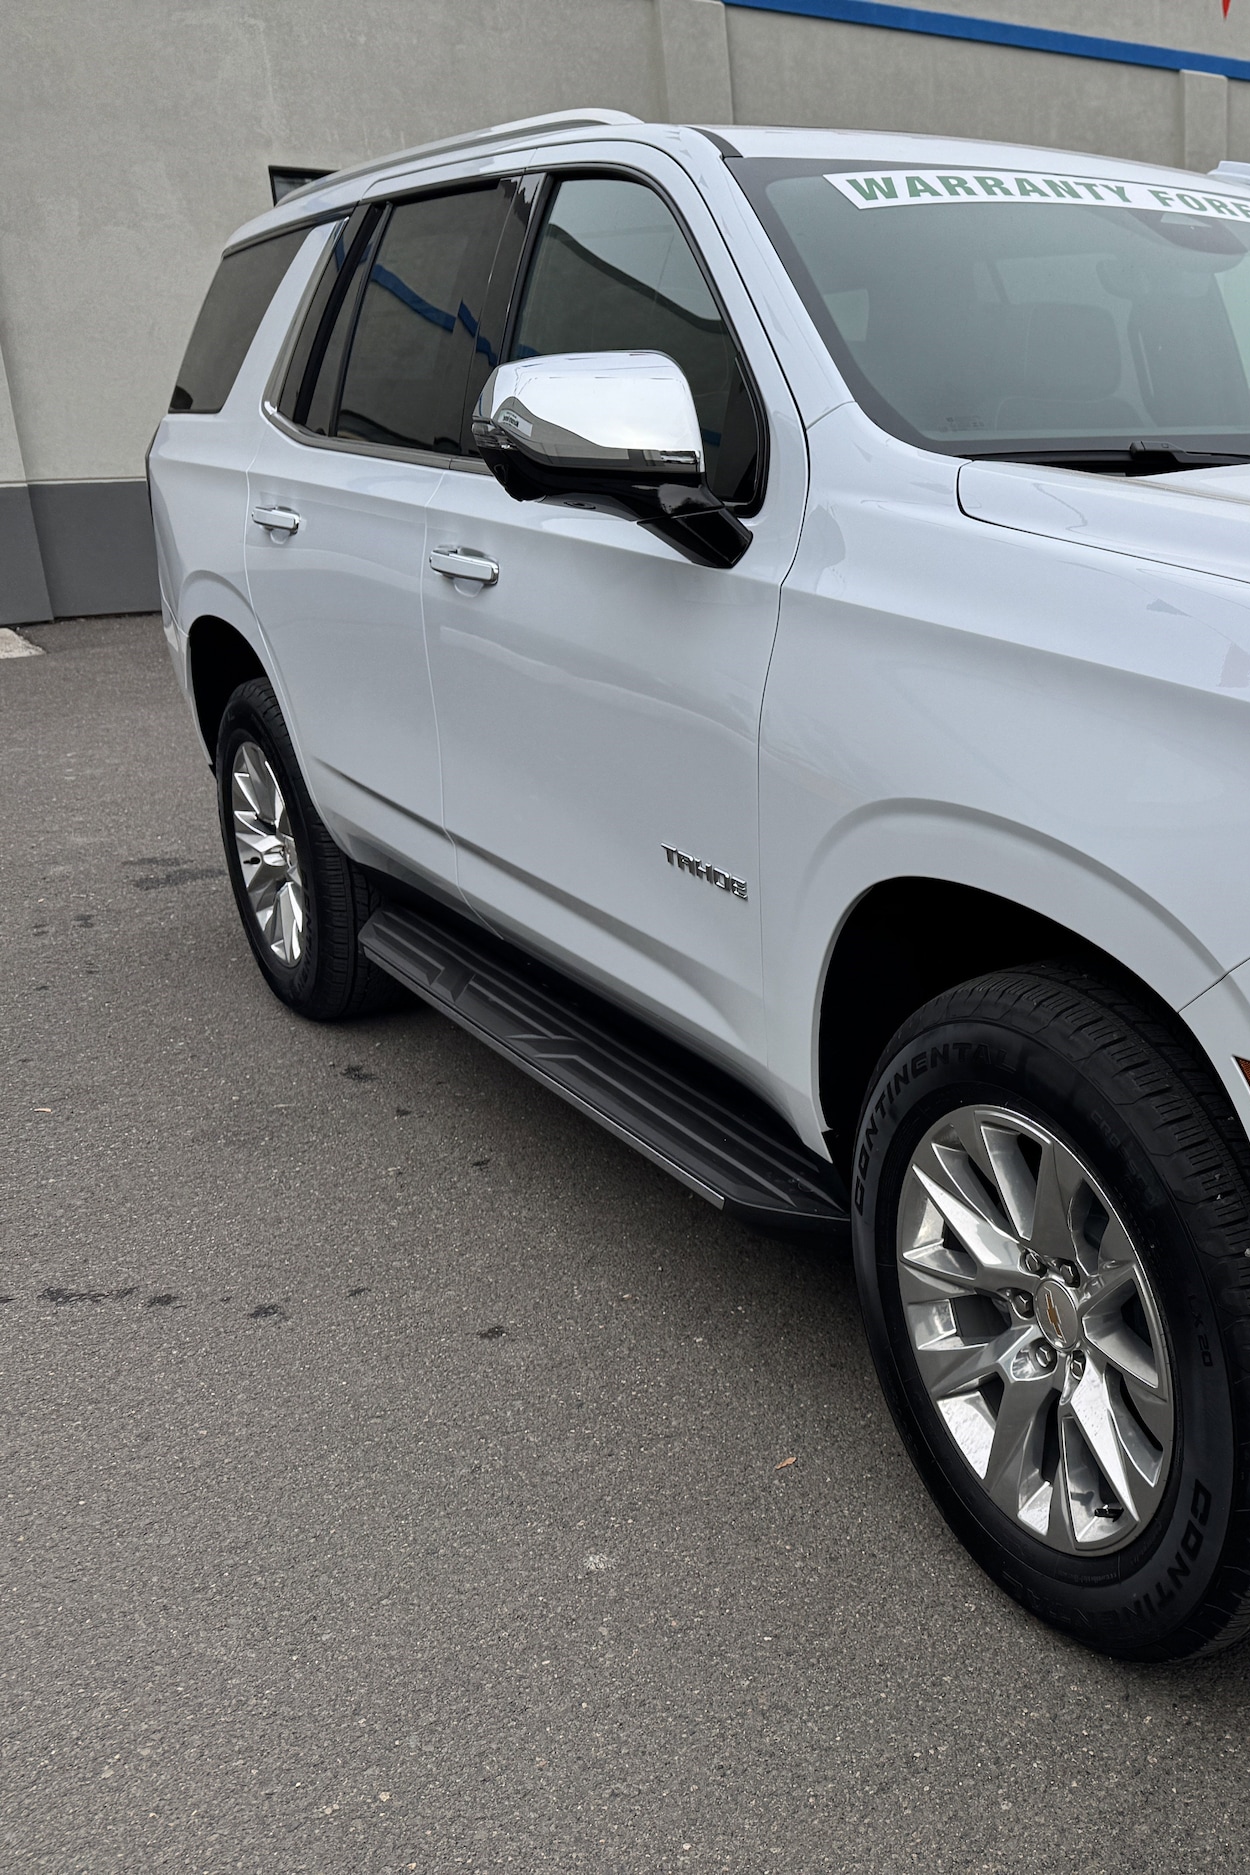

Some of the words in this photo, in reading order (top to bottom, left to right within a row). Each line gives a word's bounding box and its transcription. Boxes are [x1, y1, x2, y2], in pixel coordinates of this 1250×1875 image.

[845, 175, 1133, 203] WARRANTY
[660, 841, 749, 902] TAHOE
[854, 1040, 1018, 1217] CONTINENTAL
